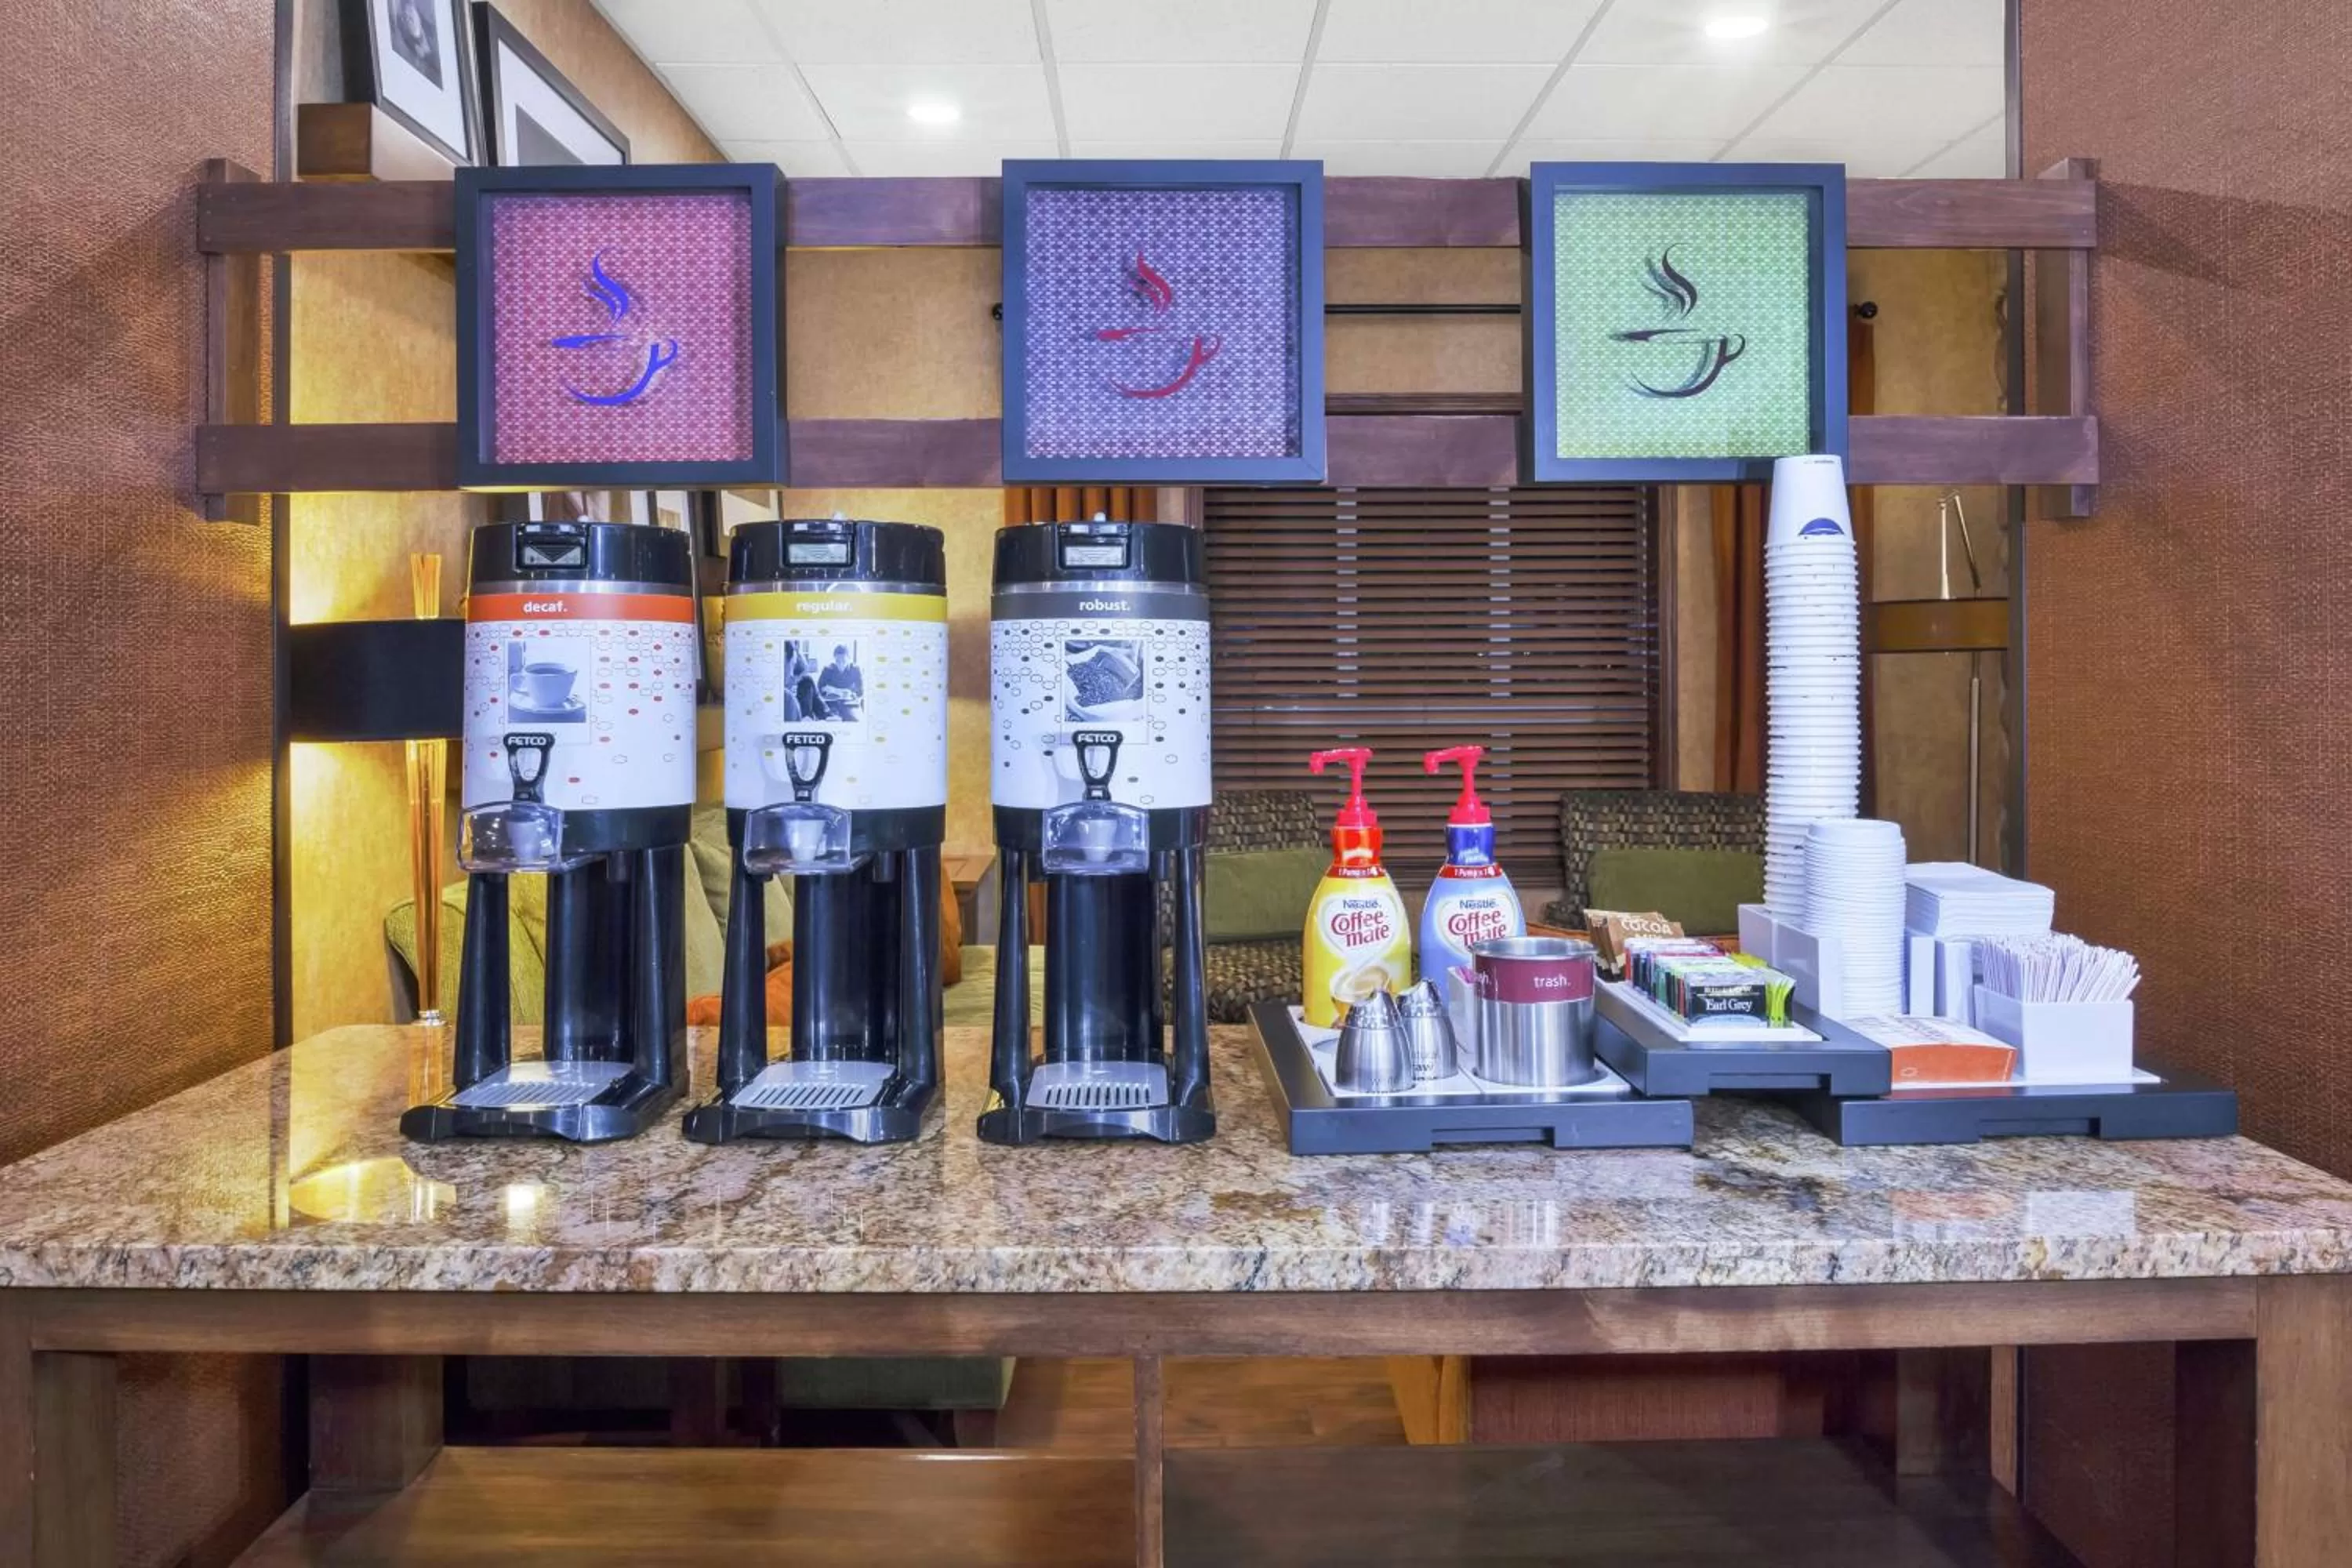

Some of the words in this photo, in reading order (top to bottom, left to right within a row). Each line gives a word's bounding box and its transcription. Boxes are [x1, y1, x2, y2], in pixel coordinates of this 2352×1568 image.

[523, 600, 568, 612] decaf.
[796, 600, 853, 614] regular.
[1079, 598, 1131, 611] robust.
[508, 737, 546, 746] FETCO
[786, 735, 826, 744] FETCO
[1078, 733, 1117, 743] FETCO
[1346, 924, 1390, 947] mate
[1534, 973, 1571, 988] trash.
[1705, 998, 1727, 1011] Earl
[1728, 998, 1753, 1012] Grey
